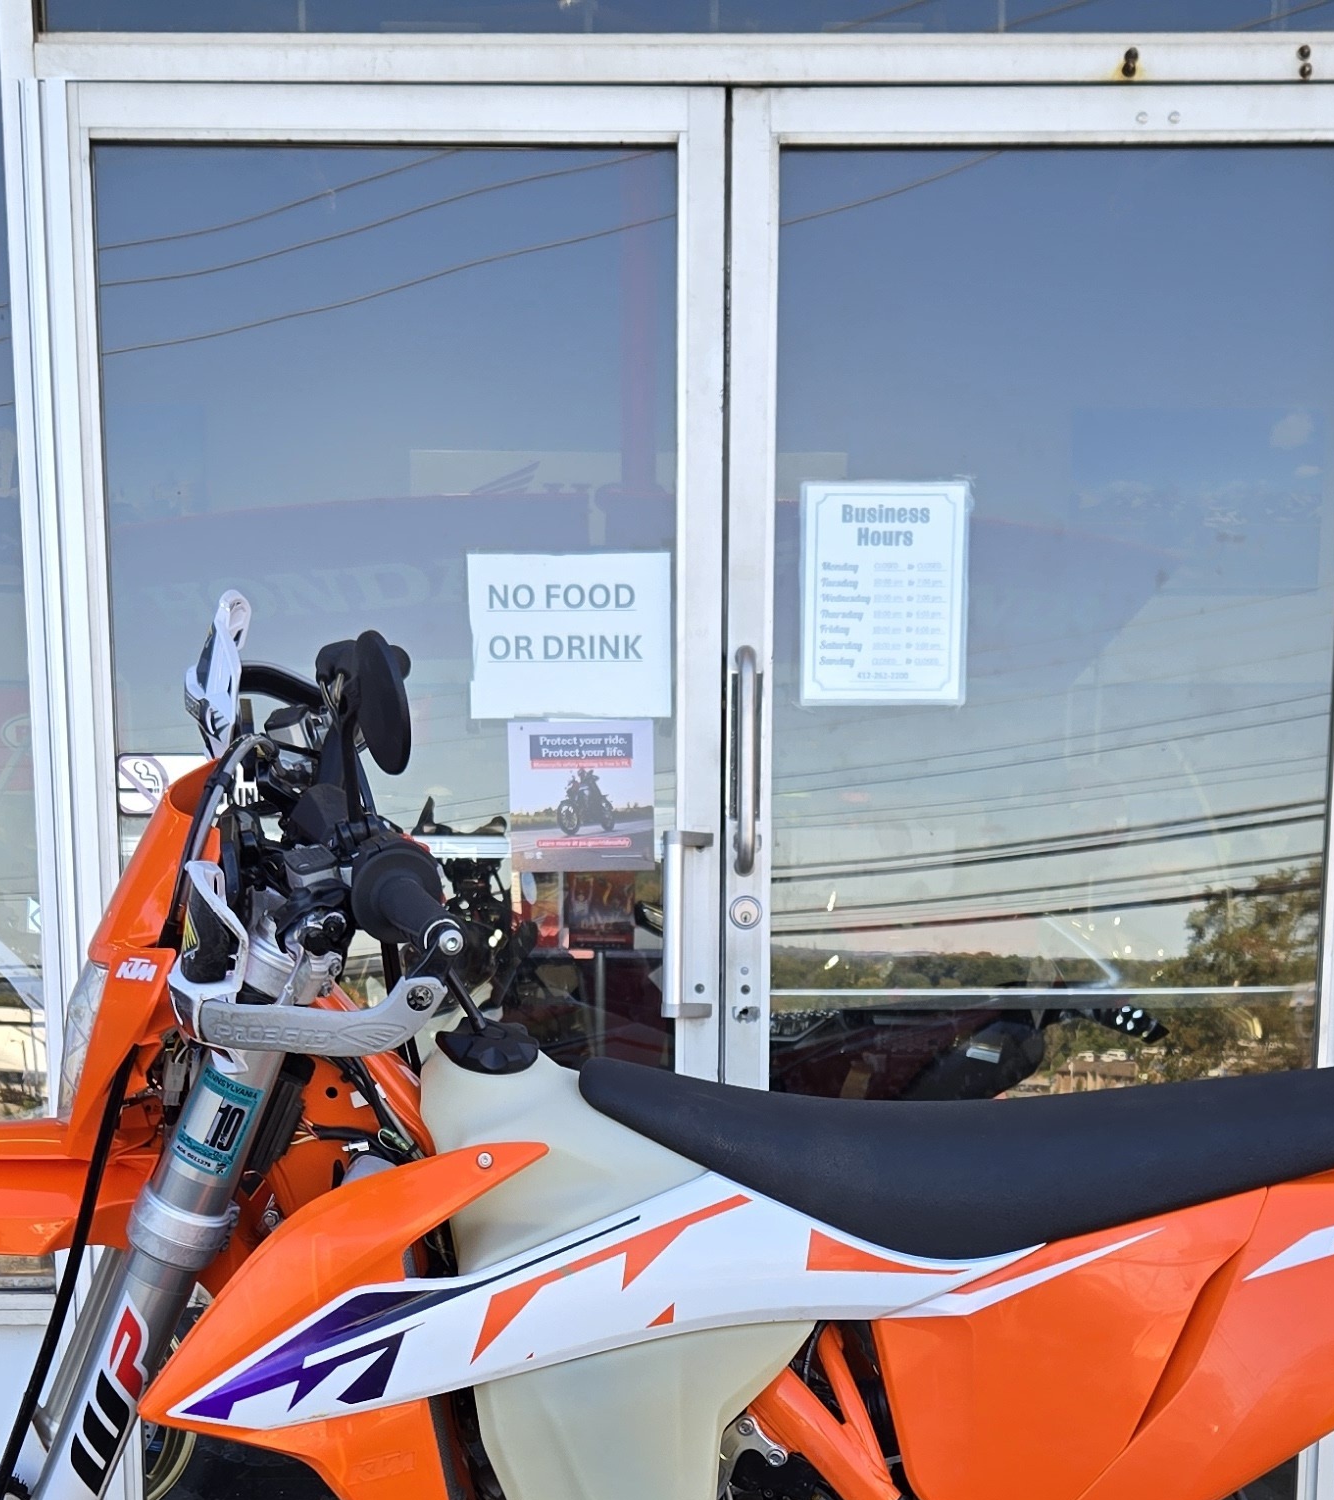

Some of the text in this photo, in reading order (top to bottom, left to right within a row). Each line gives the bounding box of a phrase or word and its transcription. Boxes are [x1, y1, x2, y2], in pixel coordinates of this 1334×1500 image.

[841, 503, 931, 524] Business
[856, 526, 914, 547] Hours
[488, 583, 636, 610] NO FOOD
[489, 634, 643, 660] OR DRINK
[539, 734, 628, 747] Protect your ride.
[541, 747, 626, 760] Protect your life.
[115, 957, 158, 982] KTM
[203, 1066, 259, 1099] PENNSYLVANIA
[70, 1305, 144, 1497] WP
